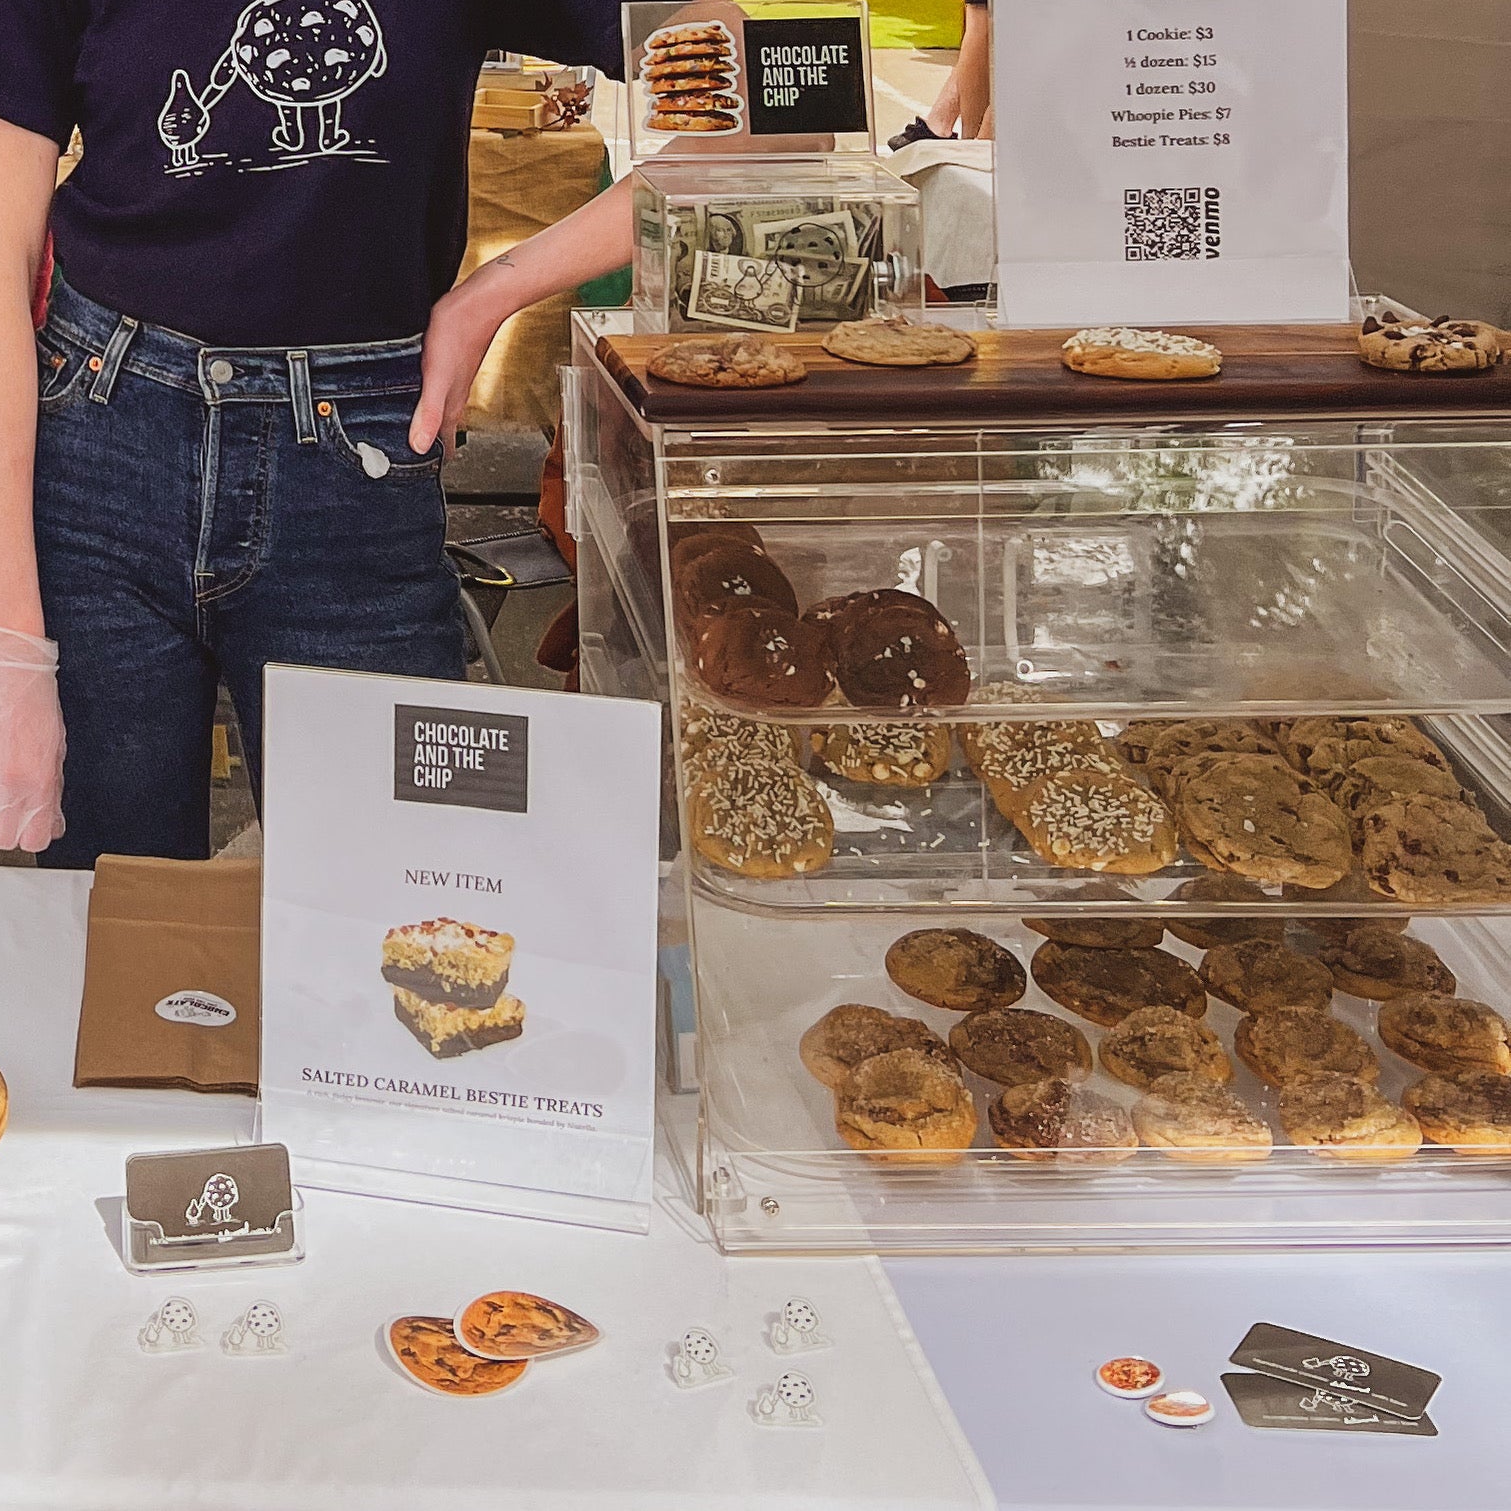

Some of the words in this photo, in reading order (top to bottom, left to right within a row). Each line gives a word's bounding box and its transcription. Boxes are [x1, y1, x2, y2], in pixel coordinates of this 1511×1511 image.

[1126, 29, 1133, 41] 1
[1136, 28, 1192, 41] Cookie:
[1195, 26, 1214, 41] $3
[760, 44, 849, 66] CHOCOLATE
[1140, 55, 1189, 68] dozen:
[1193, 53, 1217, 68] $15
[762, 67, 795, 86] AND
[797, 66, 828, 86] THE
[763, 87, 800, 107] CHIP
[1126, 83, 1132, 95] 1
[1136, 82, 1184, 95] dozen:
[1188, 80, 1216, 95] $30
[1110, 109, 1175, 124] Whoopie
[1178, 108, 1212, 121] Pies:
[1215, 106, 1232, 121] $7
[1111, 135, 1156, 148] Bestie
[1159, 134, 1209, 147] Treats:
[1213, 132, 1231, 147] $8
[1204, 187, 1221, 260] venmo
[414, 721, 510, 751] CHOCOLATE
[413, 743, 449, 767] AND
[452, 747, 485, 770] THE
[413, 765, 453, 789] CHIP
[405, 868, 451, 887] NEW
[455, 873, 503, 894] ITEM
[301, 1067, 369, 1088] SALTED
[374, 1077, 461, 1100] CARAMEL
[466, 1088, 529, 1109] BESTIE
[533, 1096, 603, 1118] TREATS
